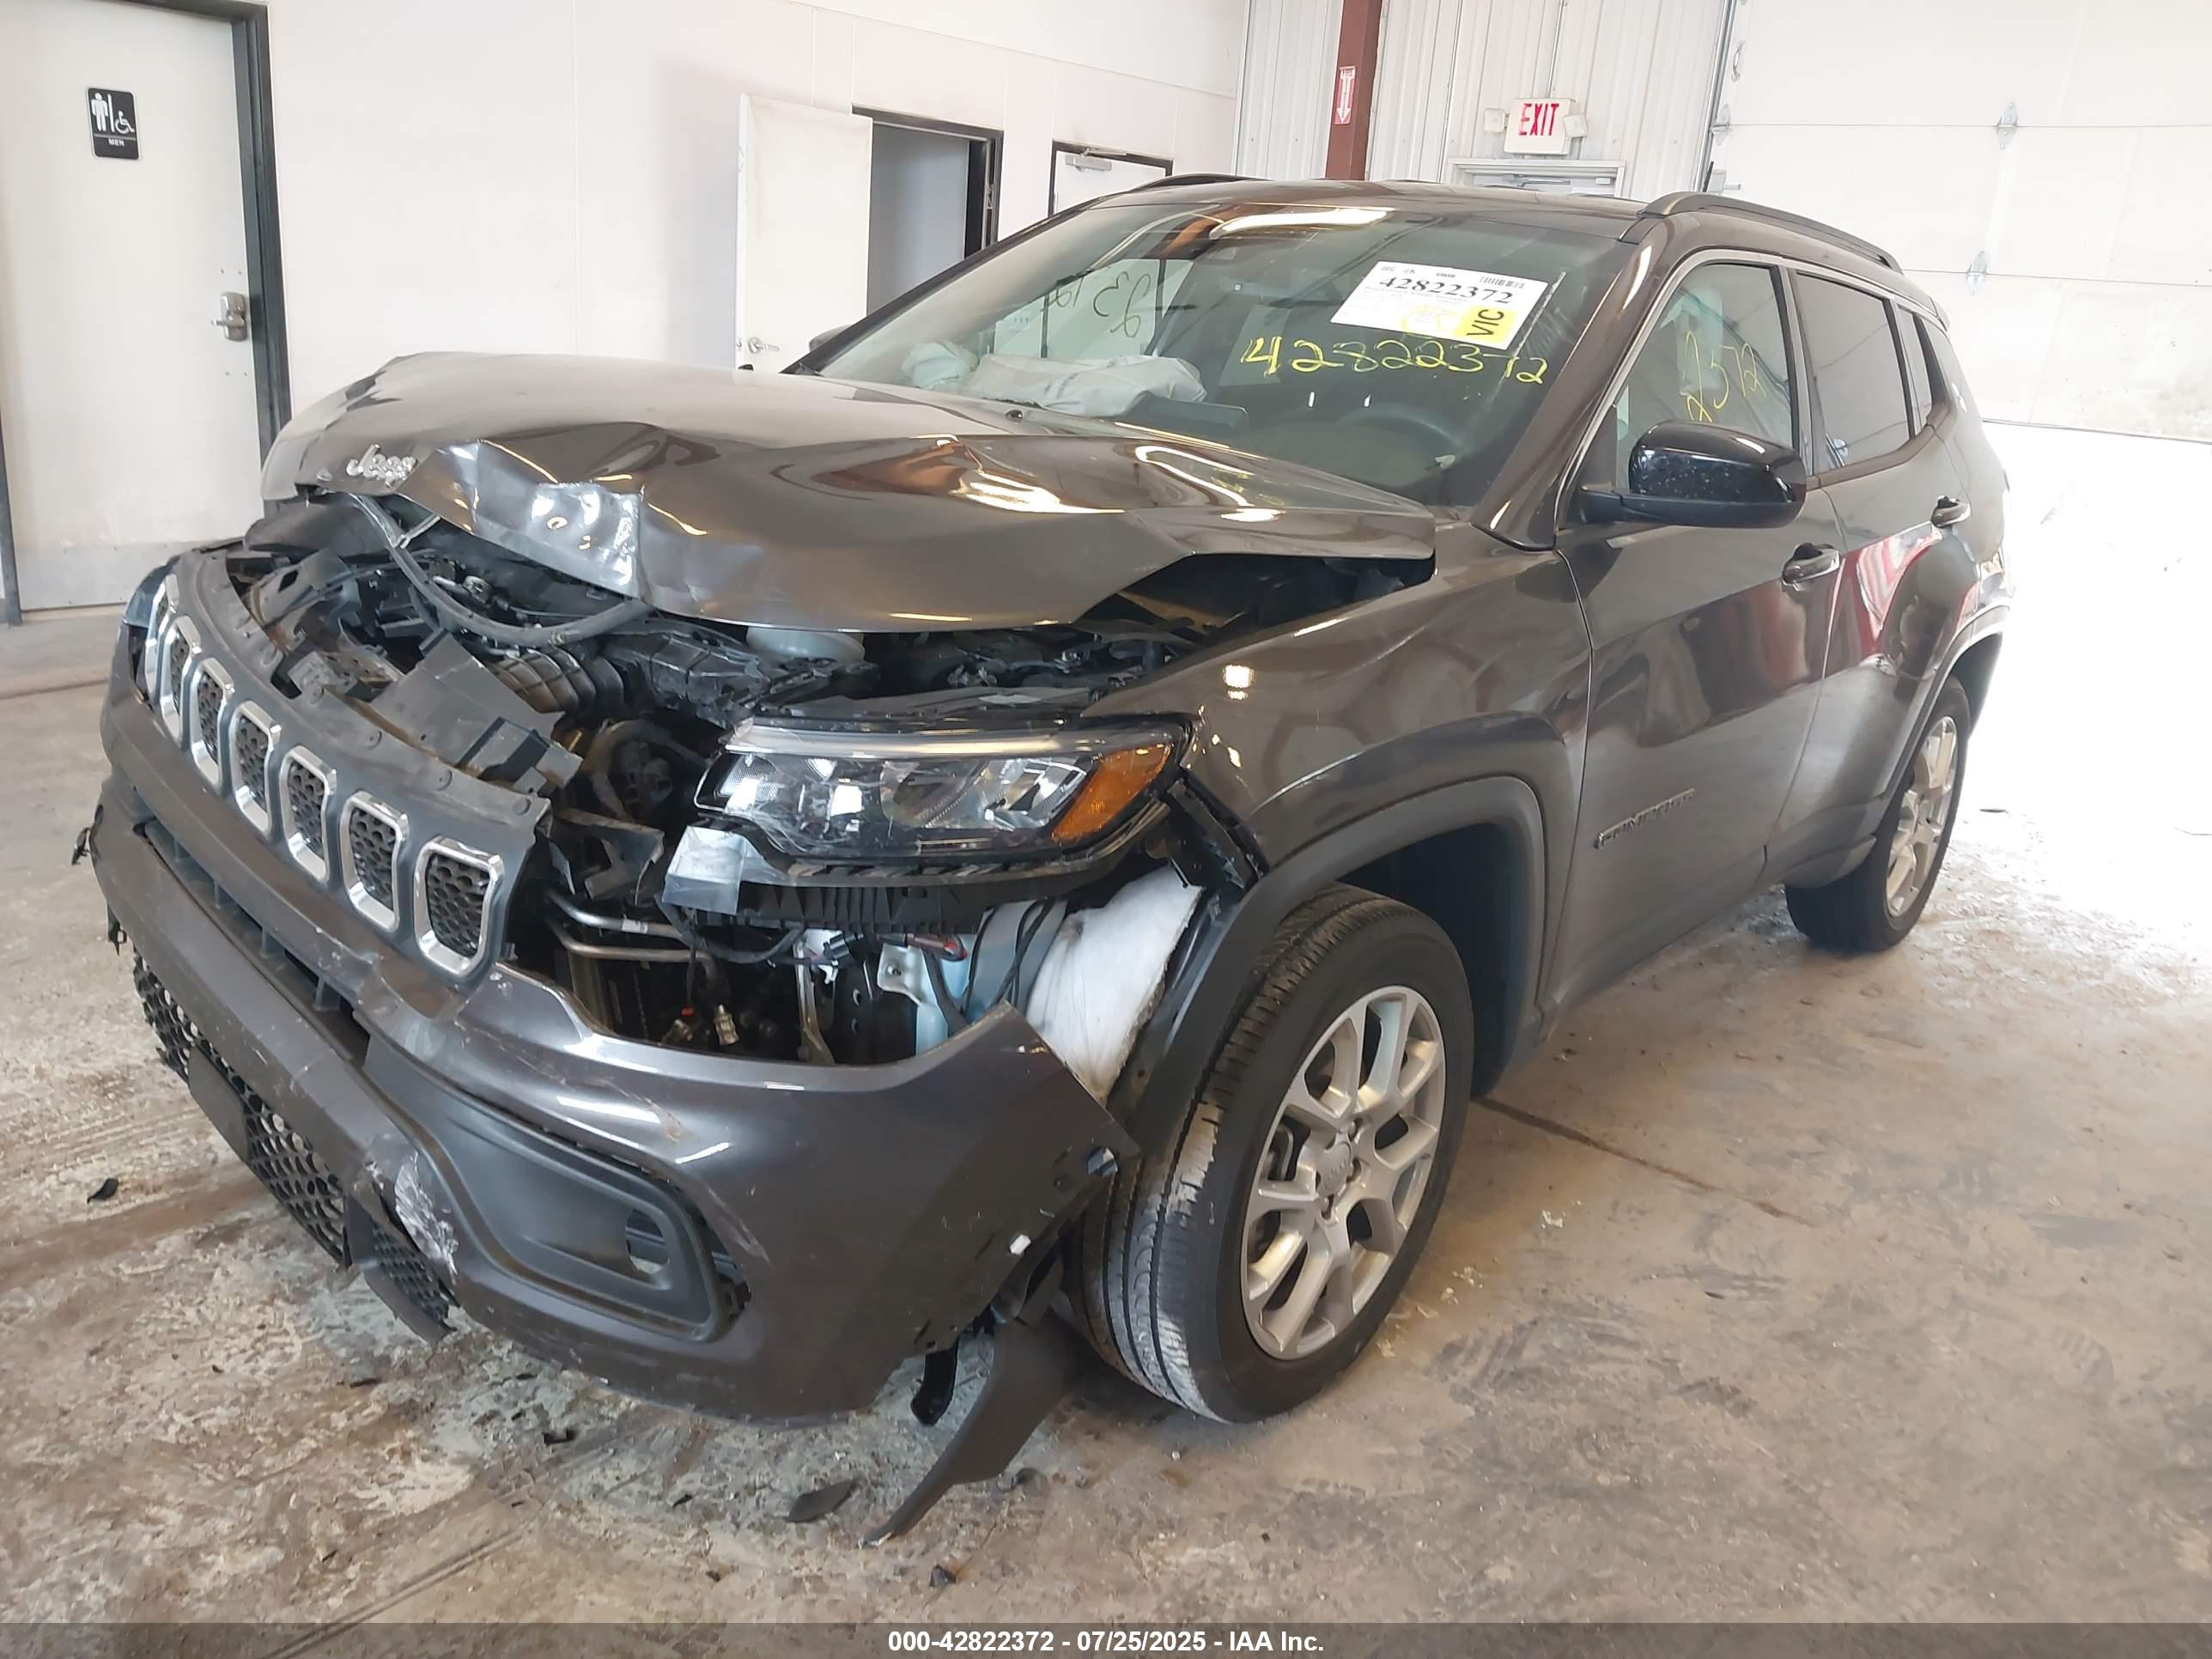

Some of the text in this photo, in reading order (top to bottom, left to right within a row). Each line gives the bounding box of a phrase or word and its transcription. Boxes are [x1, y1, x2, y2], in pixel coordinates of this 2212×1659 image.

[1518, 103, 1559, 136] EXIT
[1379, 276, 1514, 304] 42822372
[1466, 309, 1504, 336] VIC
[1240, 336, 1547, 384] 42822372
